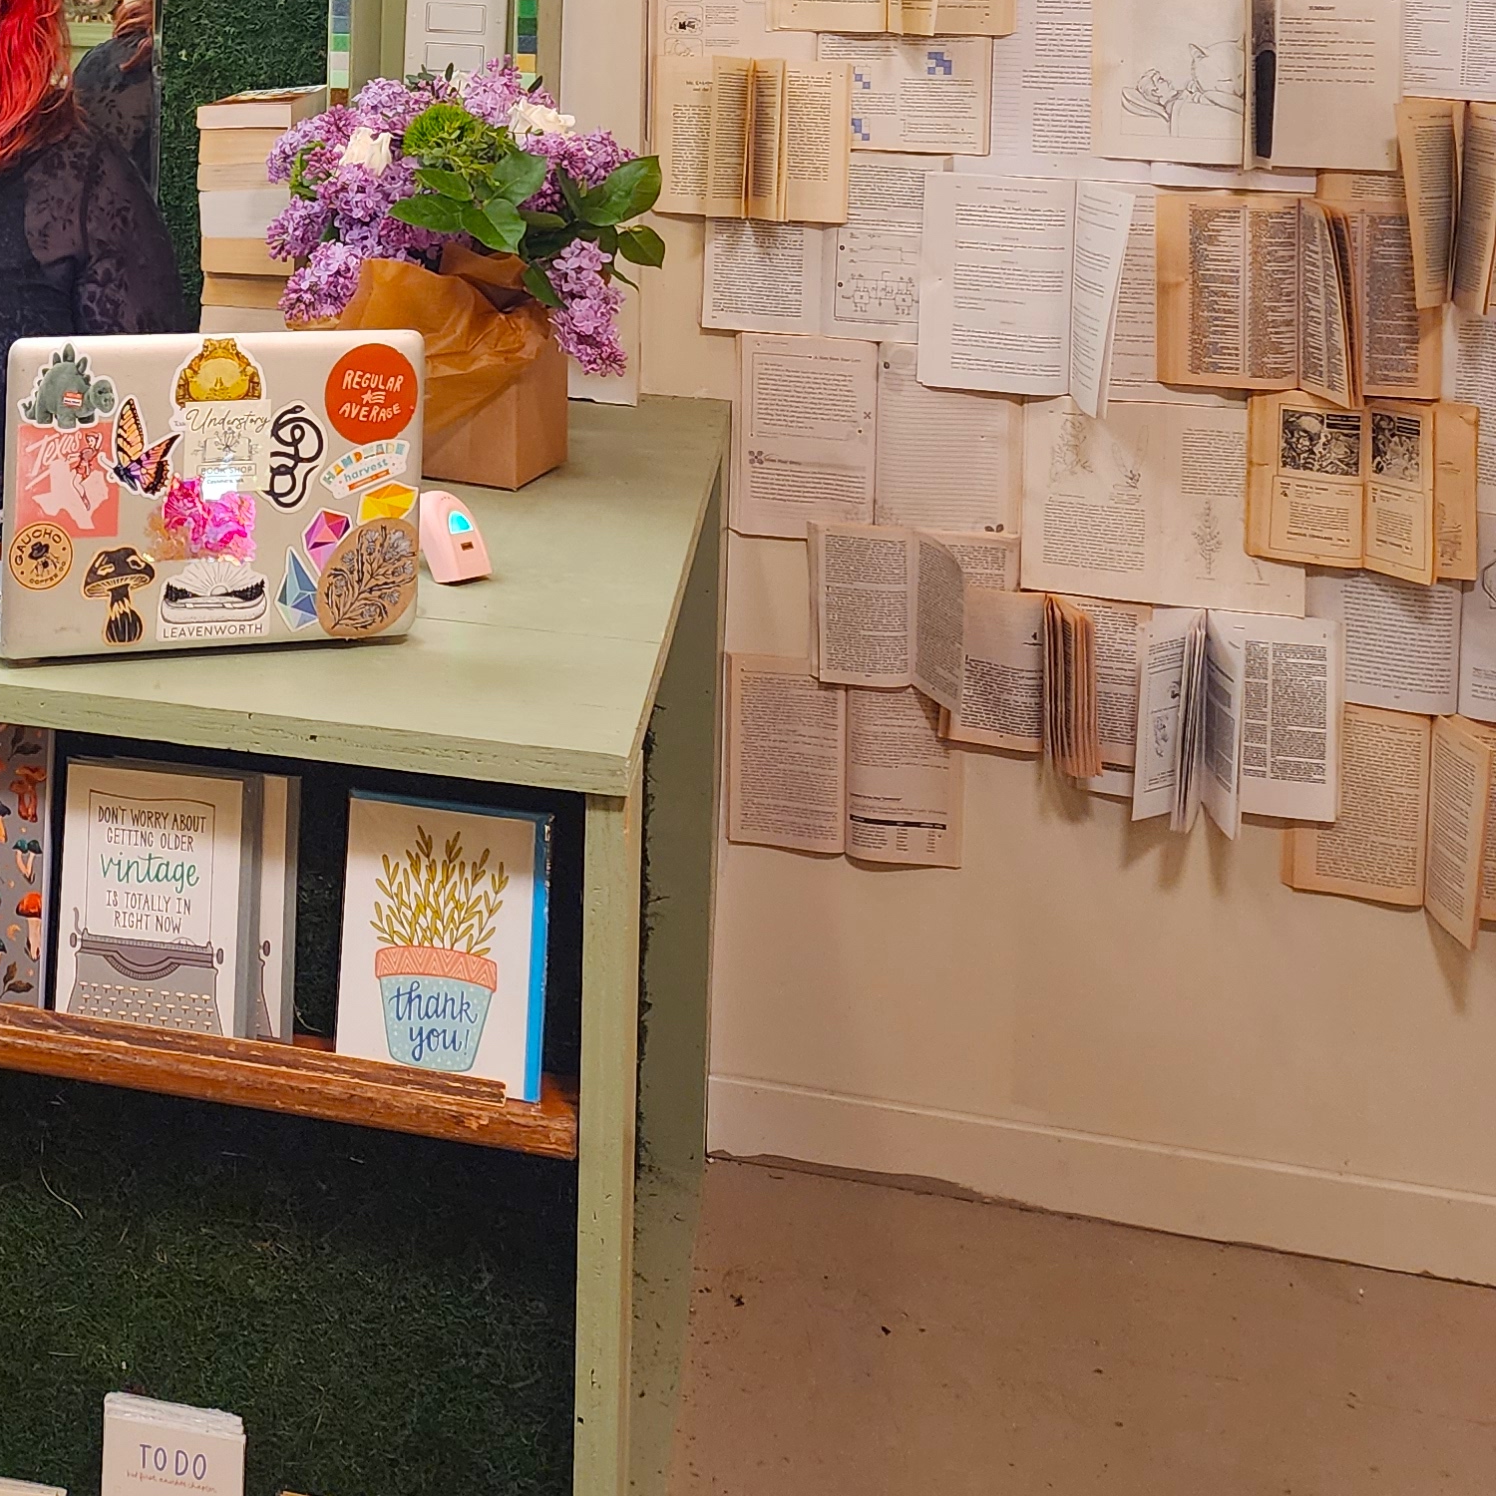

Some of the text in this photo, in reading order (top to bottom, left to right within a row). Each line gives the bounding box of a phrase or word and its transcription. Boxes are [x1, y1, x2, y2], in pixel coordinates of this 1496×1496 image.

[341, 368, 404, 394] REGULAR
[185, 408, 271, 434] Understory
[339, 402, 402, 423] AVERAGE
[25, 431, 83, 478] Texas
[344, 457, 389, 483] harvest
[14, 529, 62, 566] GAUCHO
[163, 622, 264, 640] LEAVENWORTH
[98, 805, 207, 834] DON'T WORRY ABOUT
[106, 826, 194, 853] GETTING OLDER
[100, 851, 200, 894] vintage
[106, 889, 191, 915] IS TOTALLY IN
[113, 910, 182, 934] RIGHT NOW
[388, 980, 478, 1024] thank
[409, 1025, 470, 1062] you!
[139, 1443, 207, 1481] TO DO
